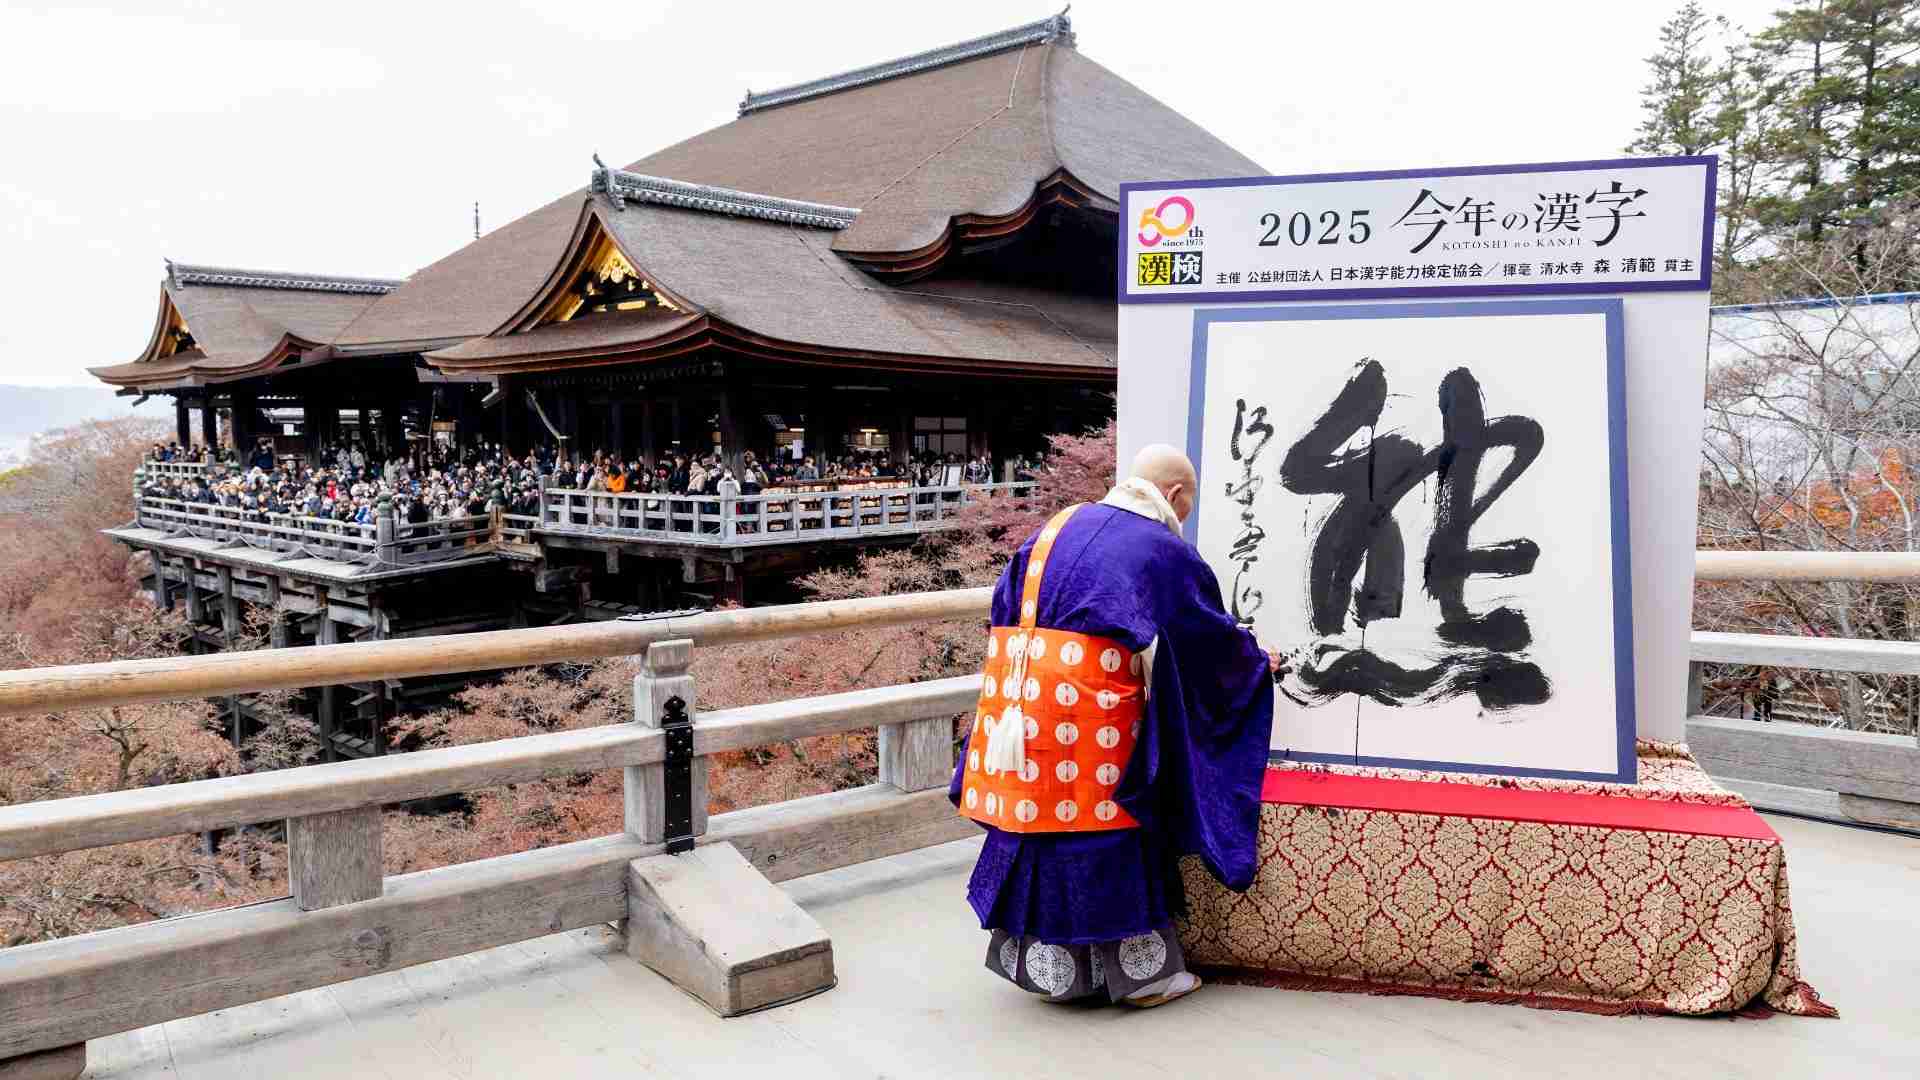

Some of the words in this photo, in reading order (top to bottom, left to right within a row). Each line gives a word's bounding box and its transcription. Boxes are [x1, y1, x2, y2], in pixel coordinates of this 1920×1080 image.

[1258, 209, 1371, 247] 2025
[1390, 181, 1649, 254] 今年の漢字
[1442, 240, 1508, 250] KOTOSHI
[1537, 238, 1582, 248] KANJI
[1139, 253, 1201, 284] 漢検
[1216, 272, 1241, 285] 主催
[1247, 270, 1324, 284] 公益財団法人
[1540, 261, 1584, 276] 清水寺
[1593, 258, 1611, 274] 森
[1621, 257, 1656, 273] 清範
[1664, 258, 1694, 272] 貫主
[1279, 358, 1554, 708] 熊
